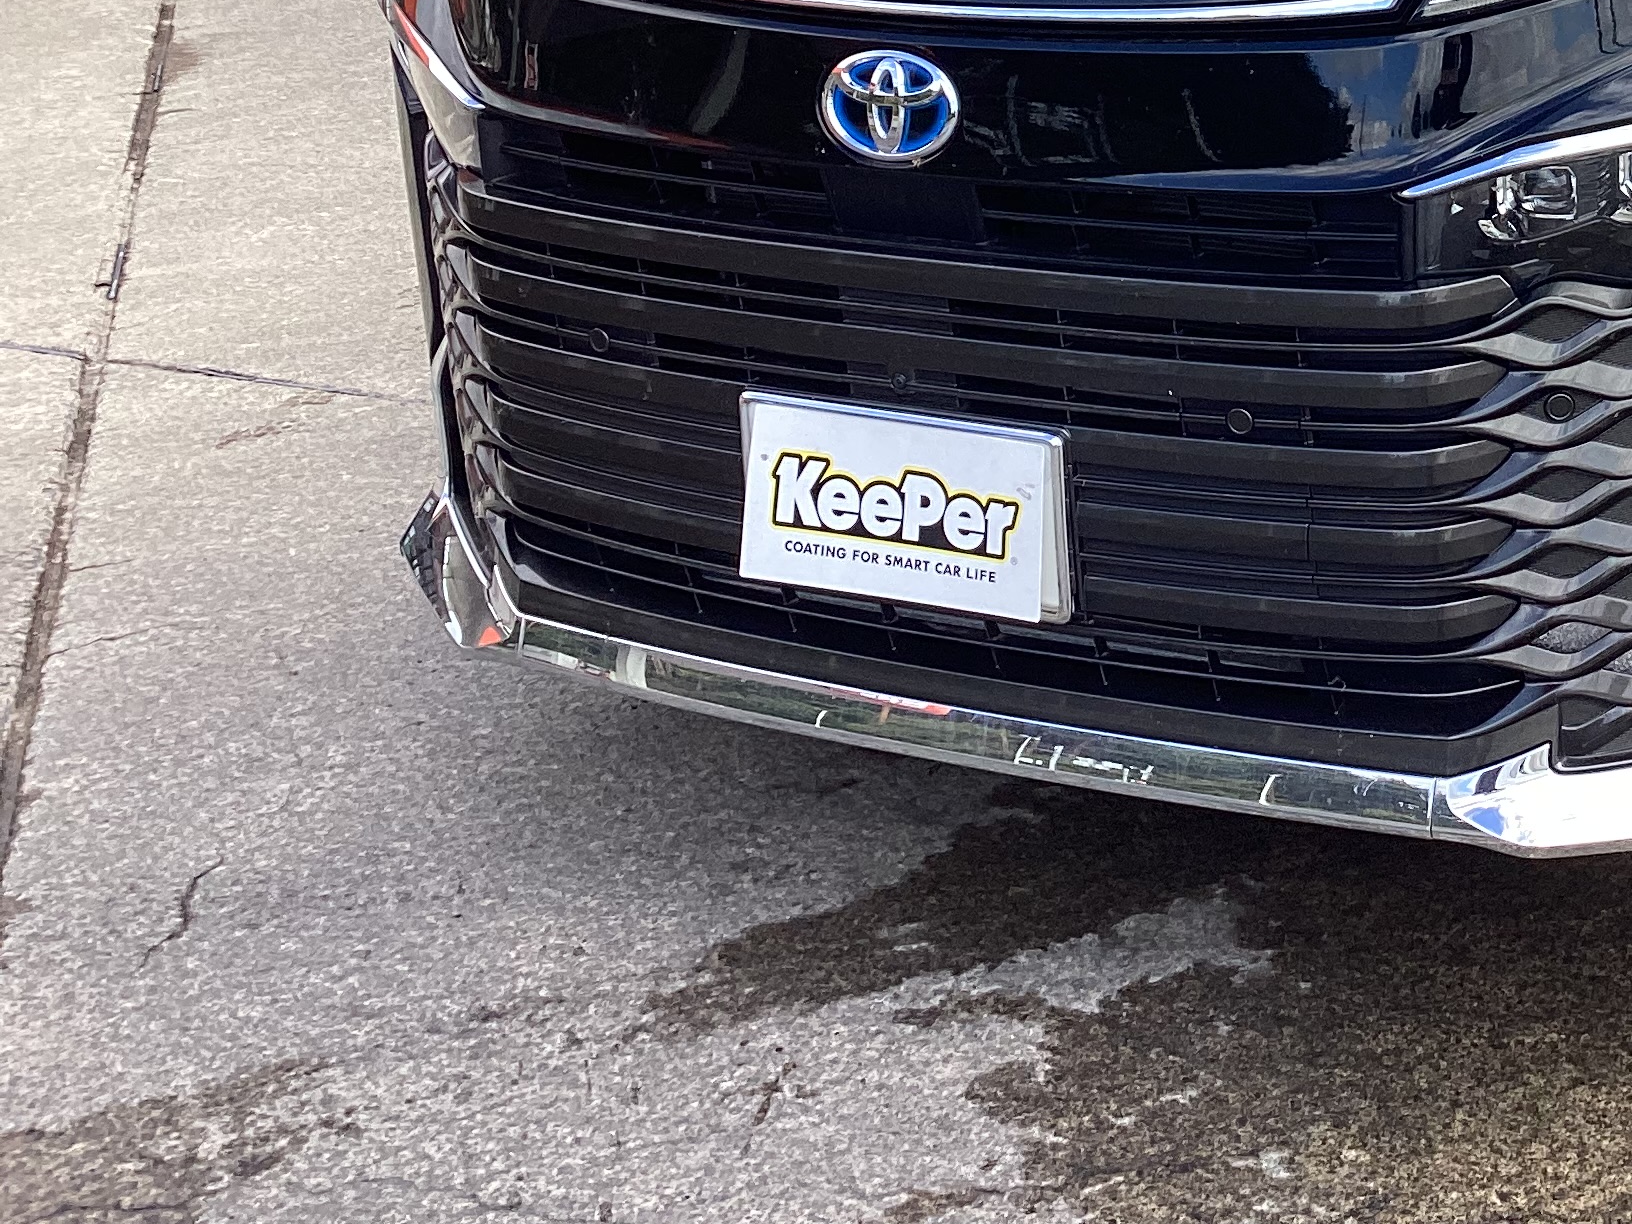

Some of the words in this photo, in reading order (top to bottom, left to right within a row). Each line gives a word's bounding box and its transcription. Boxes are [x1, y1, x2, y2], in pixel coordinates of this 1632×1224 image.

[773, 452, 1019, 559] KeePer
[784, 540, 847, 559] COATING
[852, 550, 879, 565] FOR
[885, 554, 931, 573] SMART
[935, 563, 962, 578] CAR
[966, 567, 996, 584] LIFE
